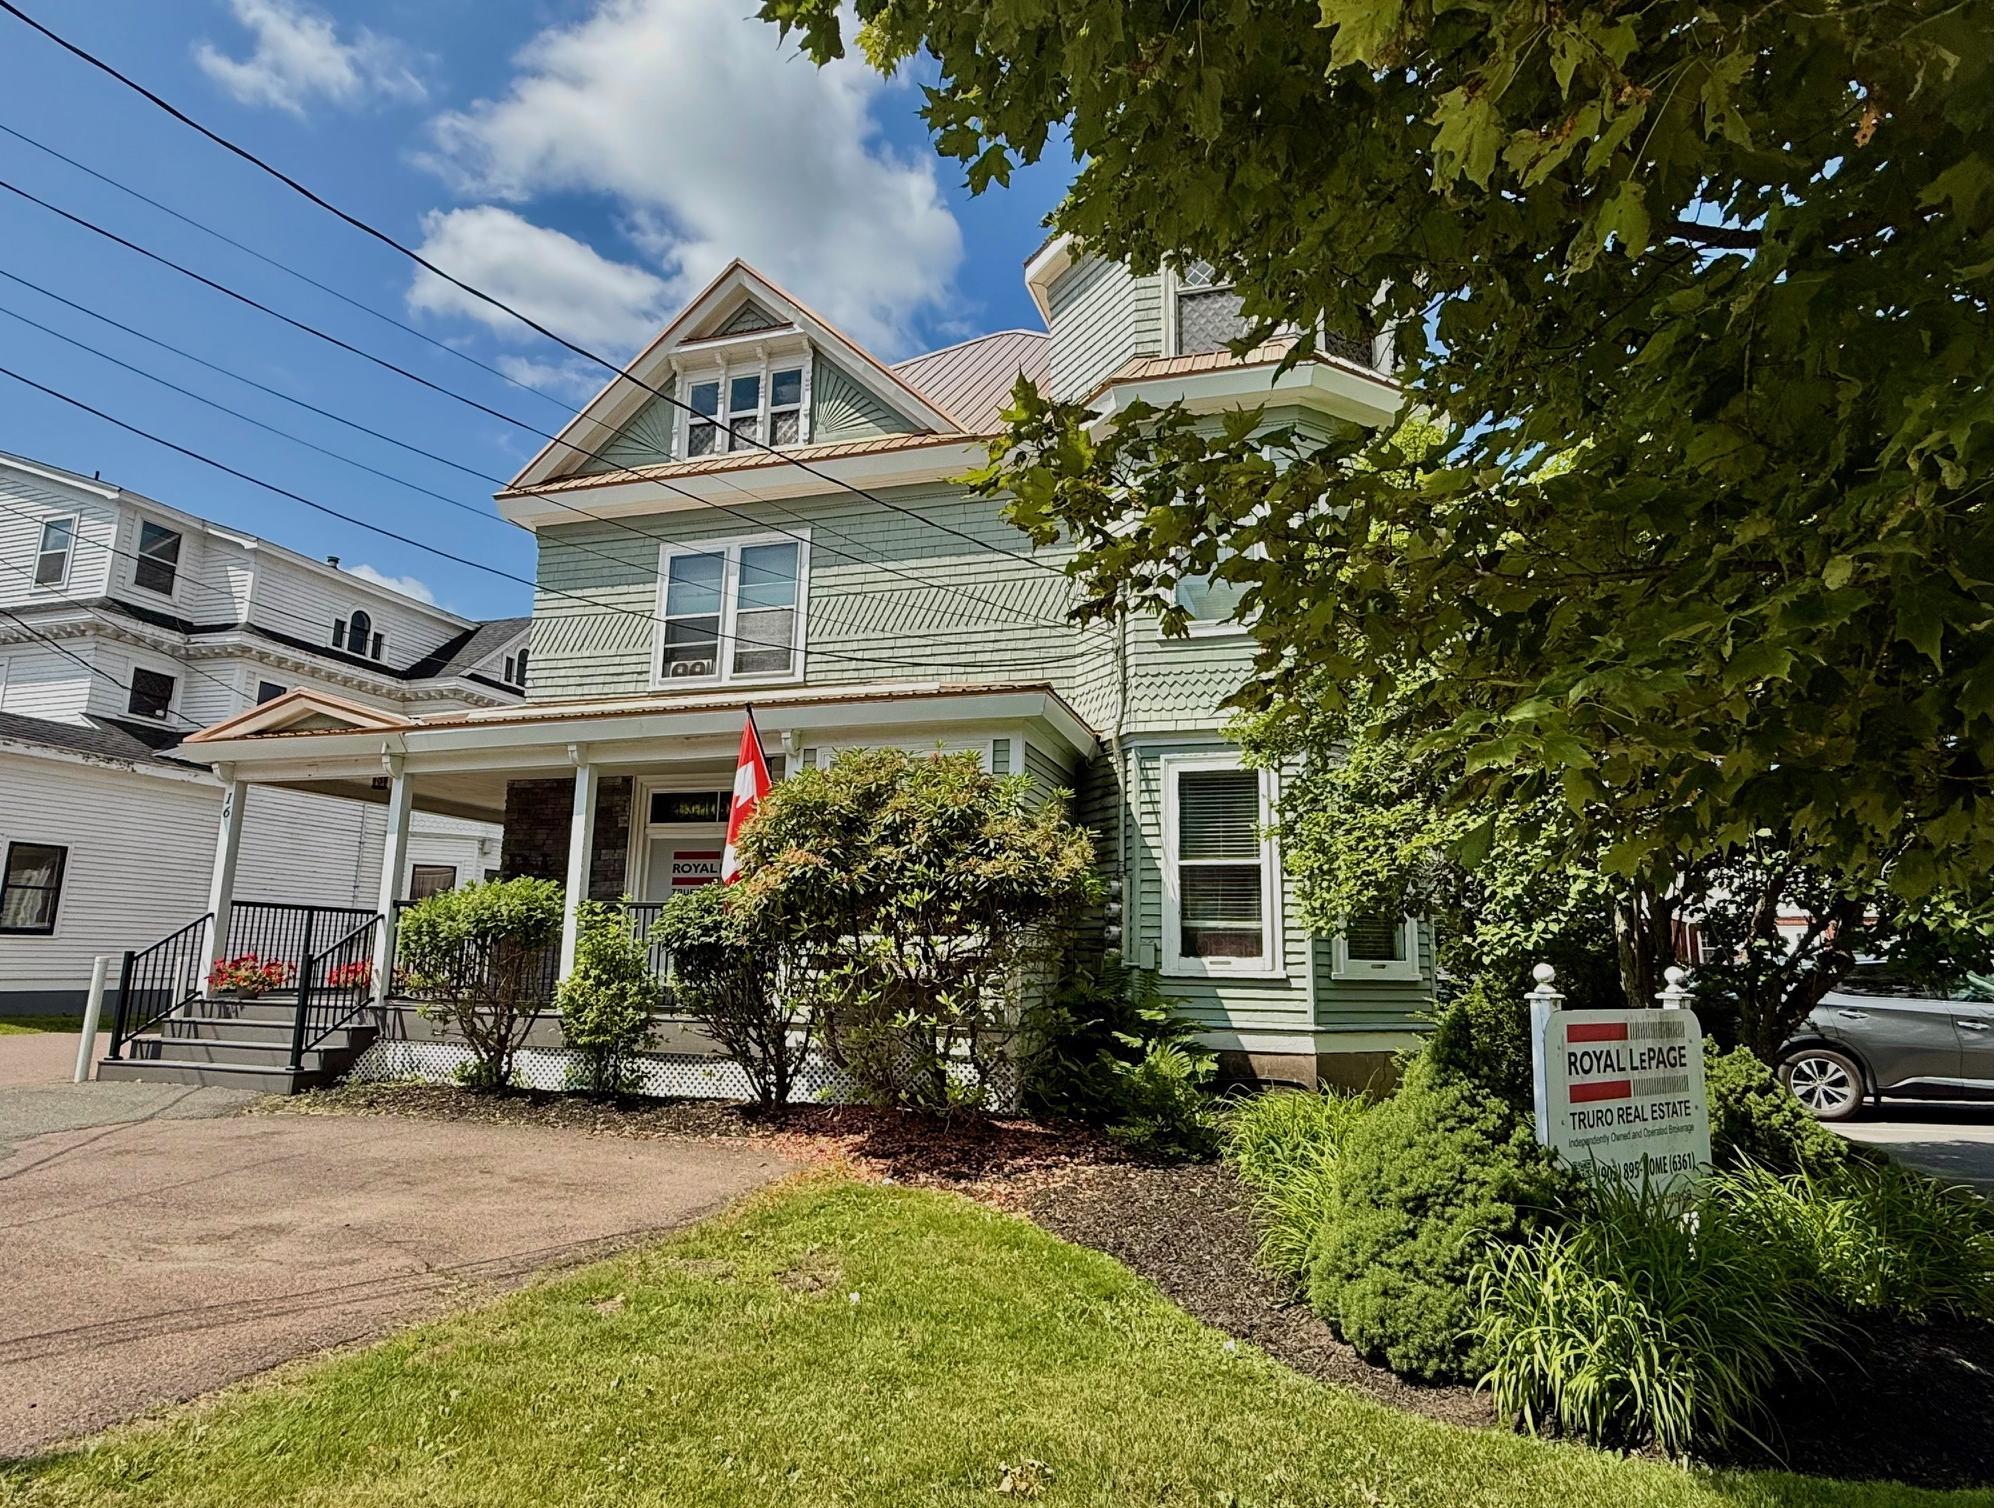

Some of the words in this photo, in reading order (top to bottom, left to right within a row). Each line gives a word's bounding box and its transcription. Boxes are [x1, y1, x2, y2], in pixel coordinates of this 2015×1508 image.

[223, 792, 233, 818] 16
[672, 863, 718, 874] ROYAL
[1567, 1049, 1627, 1076] ROYAL
[1569, 1108, 1614, 1131] TRURO
[1616, 1104, 1649, 1125] REAL
[1650, 1099, 1692, 1121] ESTATE
[1611, 1131, 1631, 1143] Owned
[1631, 1129, 1643, 1140] and
[1643, 1126, 1668, 1138] Operated
[1669, 1151, 1696, 1175] (6361)
